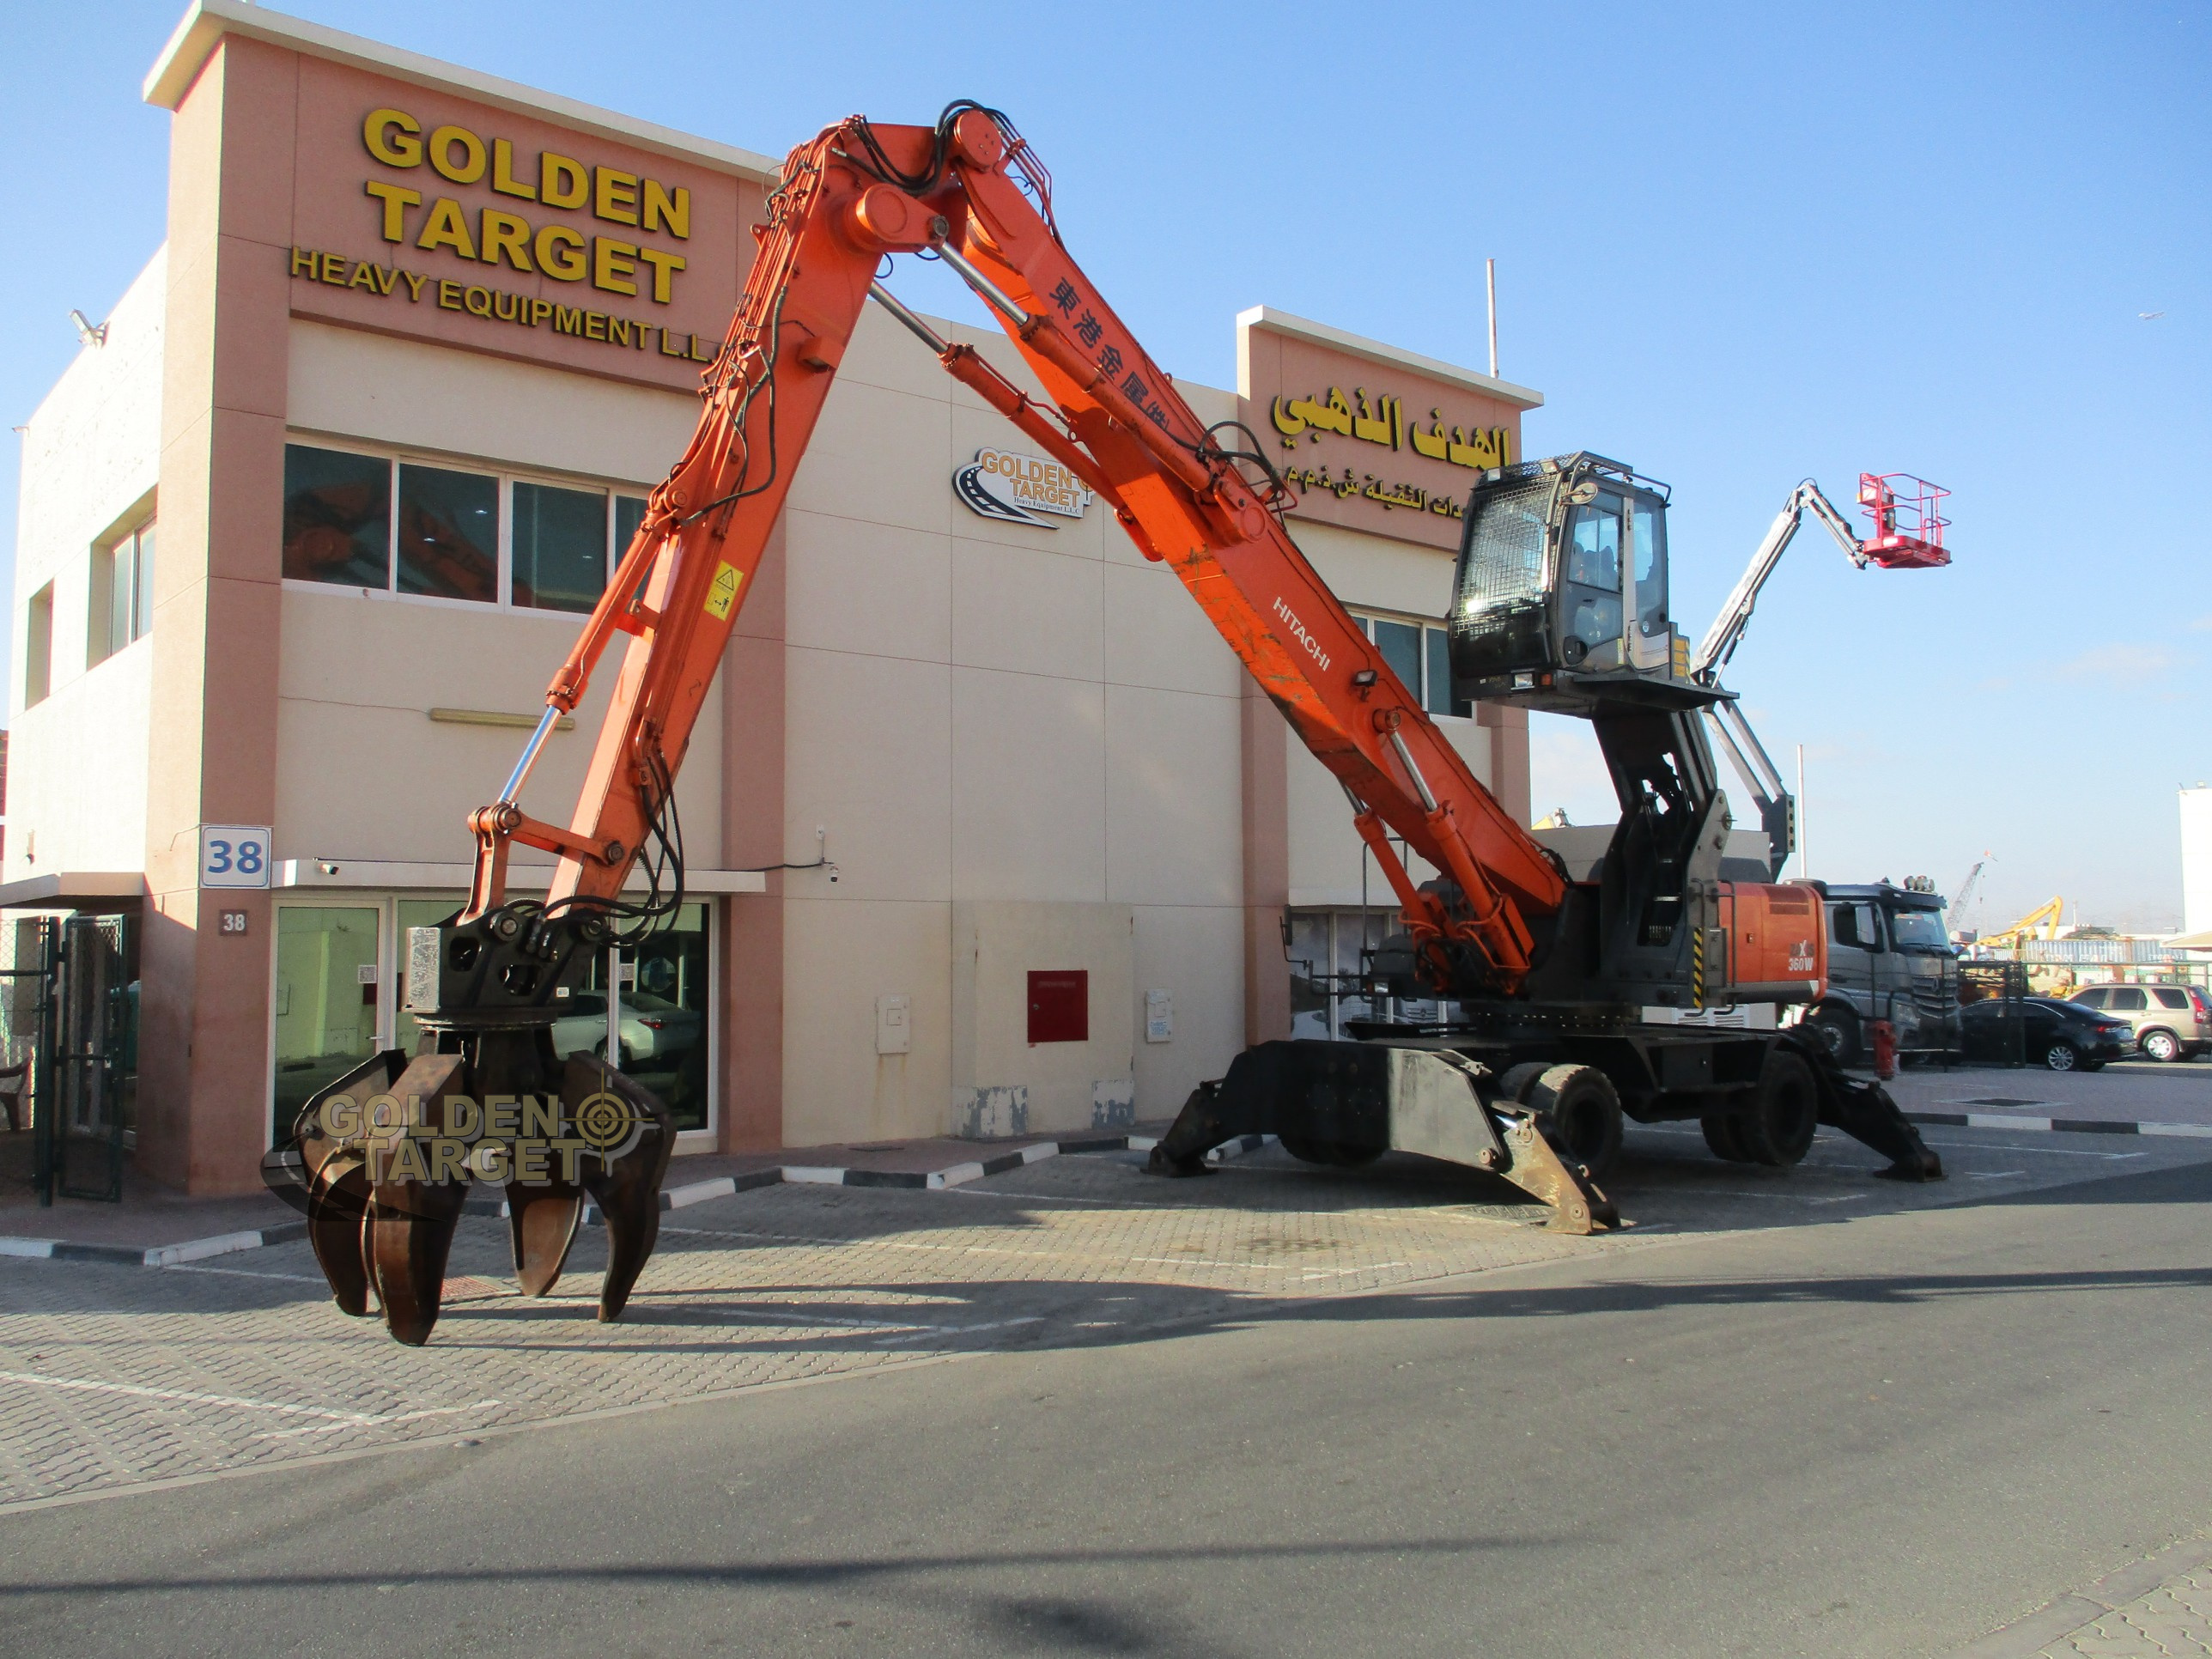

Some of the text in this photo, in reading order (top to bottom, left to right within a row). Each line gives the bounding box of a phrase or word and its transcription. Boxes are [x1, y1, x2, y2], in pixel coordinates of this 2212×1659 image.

[363, 107, 690, 240] GOLDEN
[365, 180, 686, 304] TARGET
[290, 246, 428, 302] HEAVY
[438, 279, 653, 350] EQUIPMENT
[1270, 386, 1510, 471] الهدف الذهبي
[981, 452, 1072, 489] GOLDEN
[1010, 478, 1079, 507] TARGET
[1273, 596, 1330, 672] HITACHI
[207, 840, 263, 874] 38
[223, 914, 246, 931] 38
